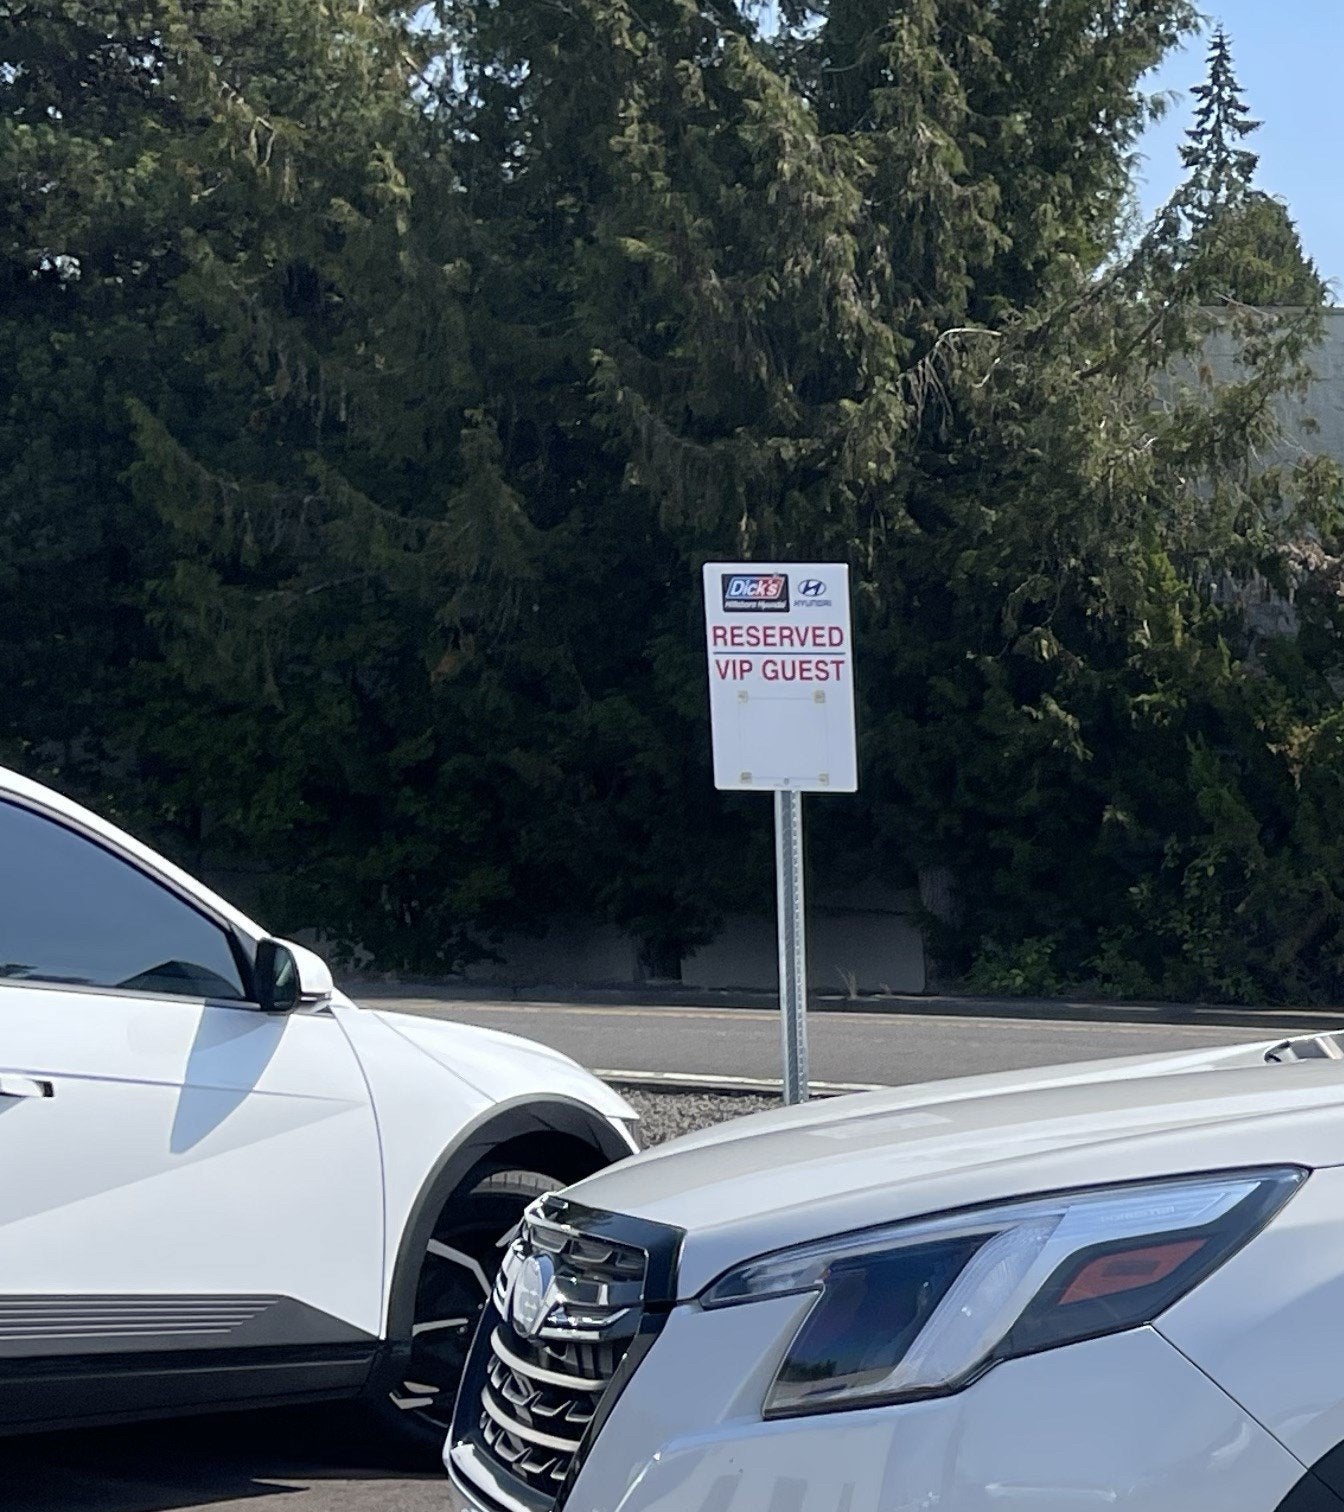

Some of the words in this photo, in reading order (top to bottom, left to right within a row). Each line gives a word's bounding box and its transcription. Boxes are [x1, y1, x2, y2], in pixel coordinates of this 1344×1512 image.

[712, 625, 844, 647] RESERVED
[715, 659, 753, 681] VIP
[762, 660, 845, 681] GUEST
